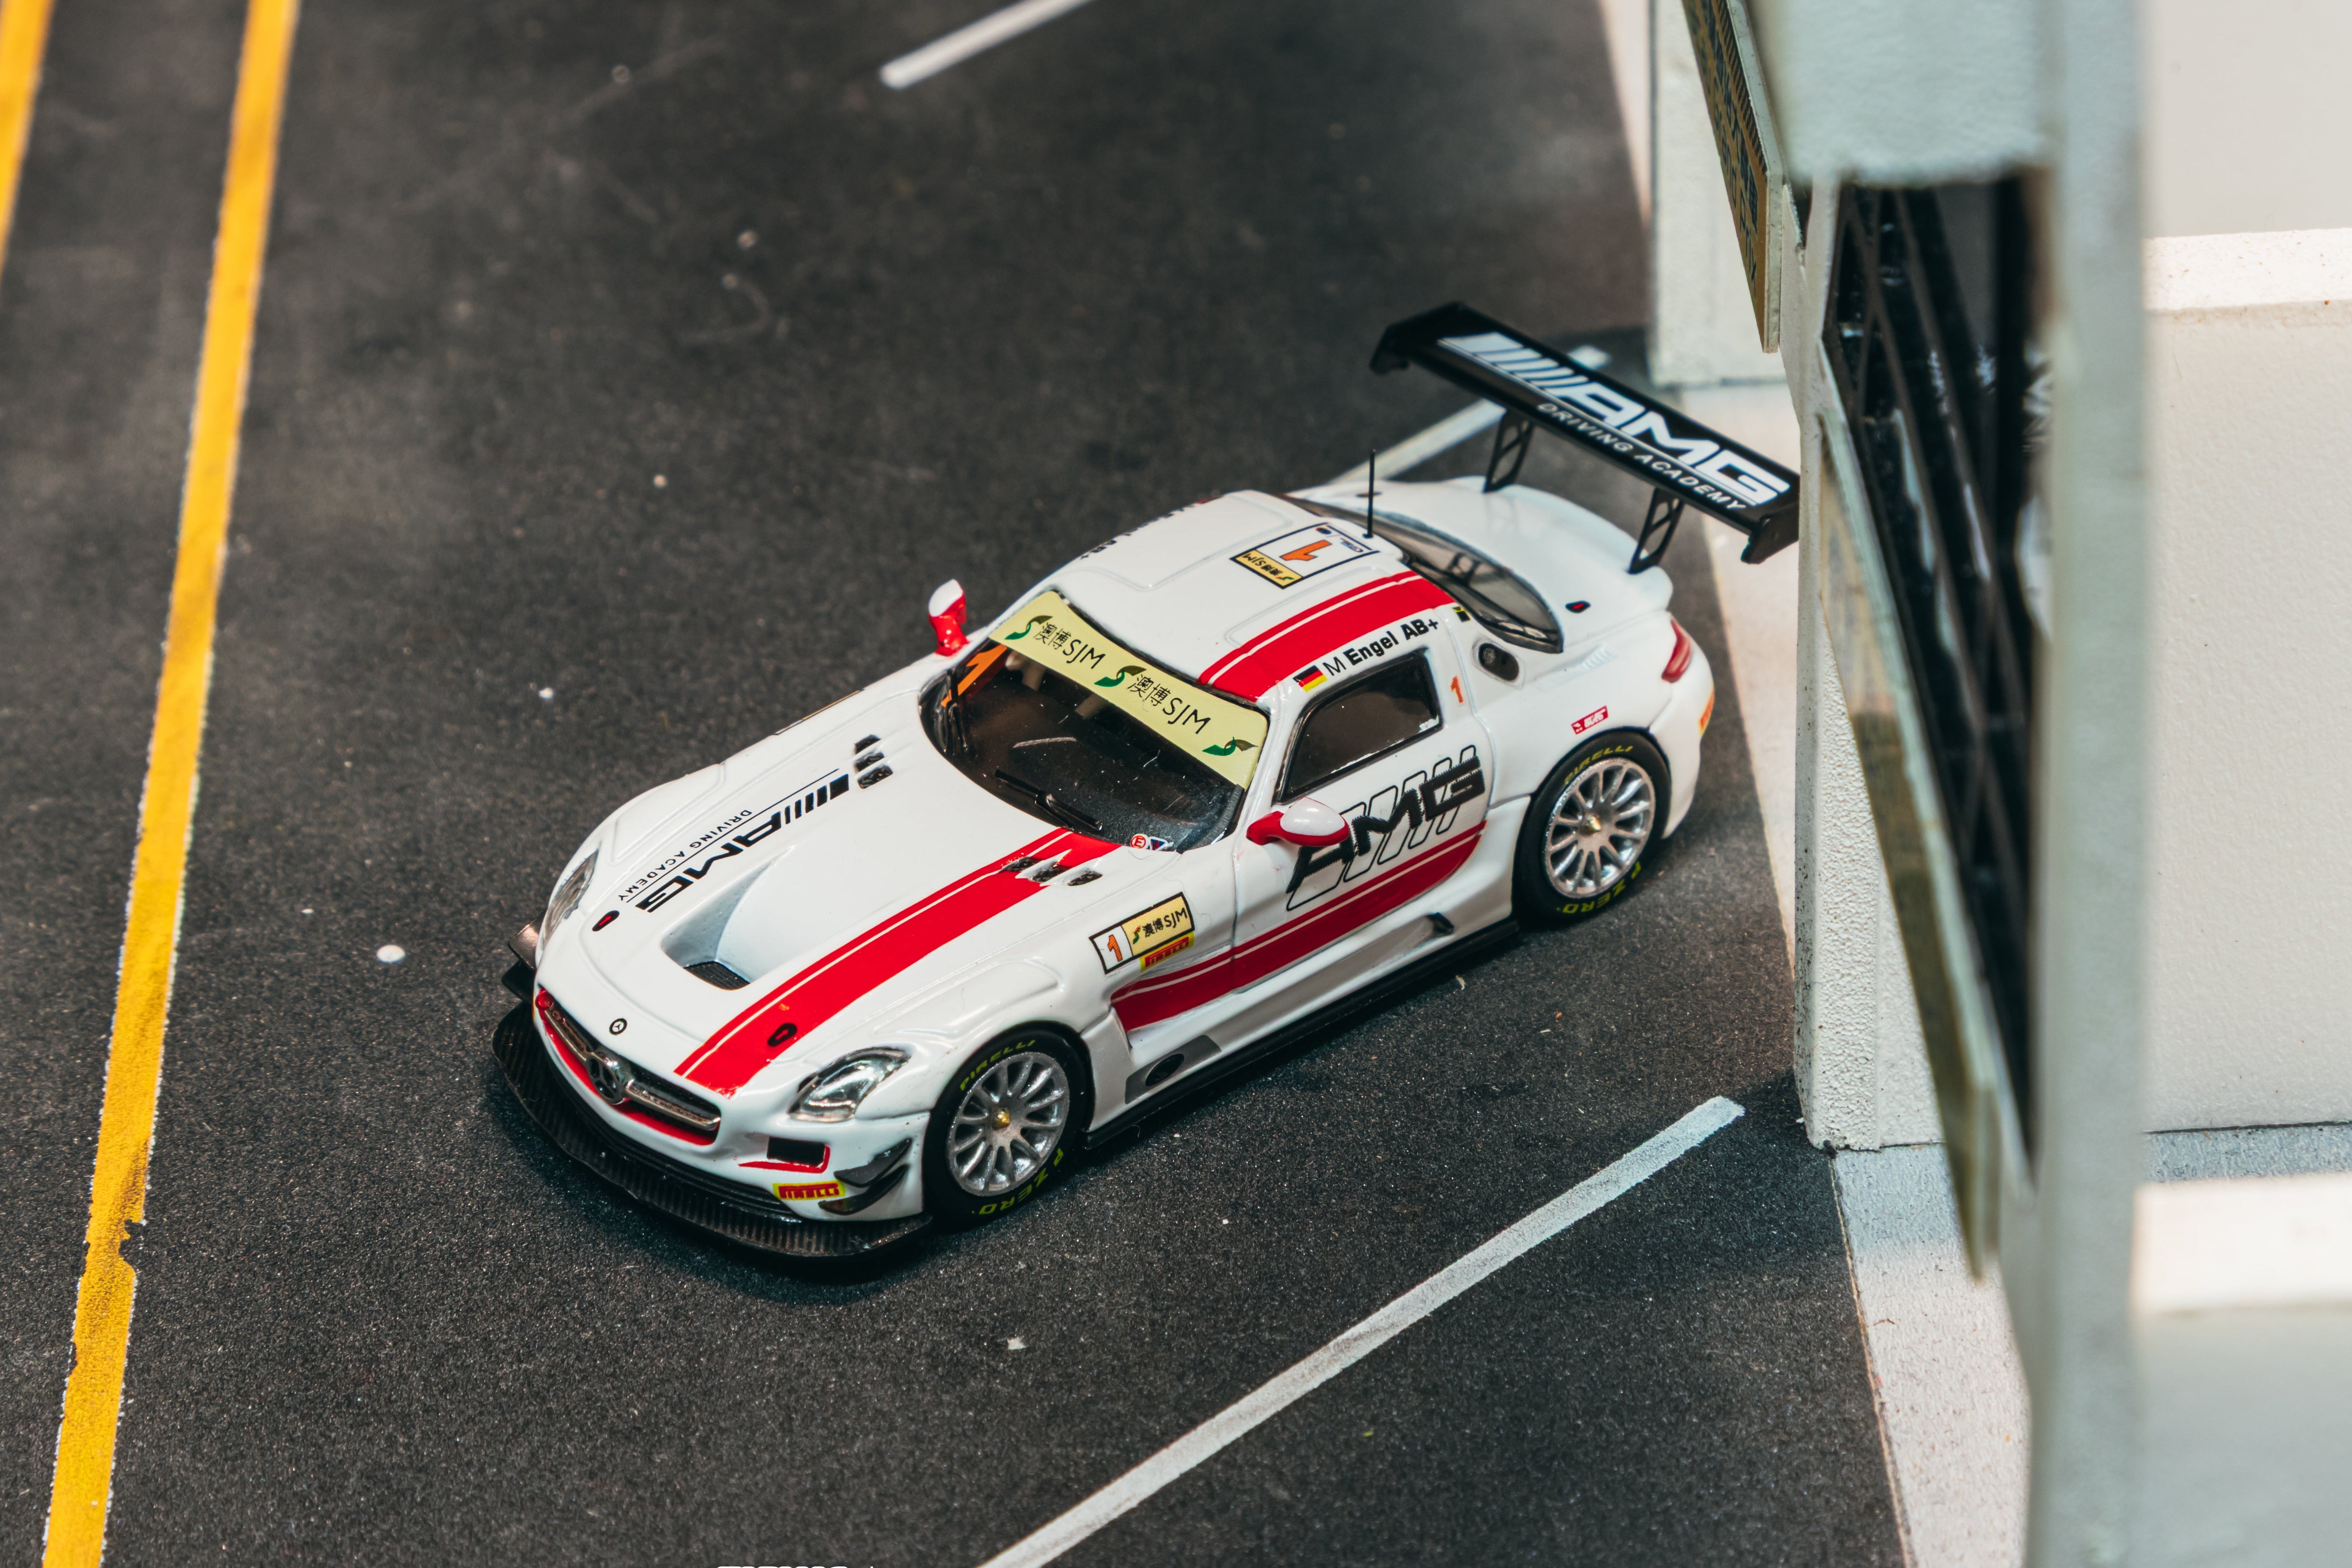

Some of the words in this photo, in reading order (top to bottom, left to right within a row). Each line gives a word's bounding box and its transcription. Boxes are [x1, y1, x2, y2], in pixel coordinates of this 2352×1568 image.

[1740, 187, 1757, 297] Prix
[1537, 403, 1633, 453] DRIVING
[1635, 454, 1746, 510] ACADEMY
[1279, 539, 1332, 561] 1
[1322, 656, 1346, 676] M
[1343, 630, 1399, 666] Engel
[1401, 619, 1439, 640] AB+
[941, 644, 1007, 707] 1
[1450, 675, 1463, 703] 1
[1564, 745, 1633, 785] PIRELLI
[689, 810, 752, 848] DRIVING
[618, 851, 685, 901] ACADEMY
[1563, 879, 1626, 913] ZERO
[1107, 934, 1123, 962] 1
[960, 1040, 1035, 1091] PIRELLI
[778, 1182, 840, 1199] PIRELLI
[979, 1168, 1048, 1215] ZERO
